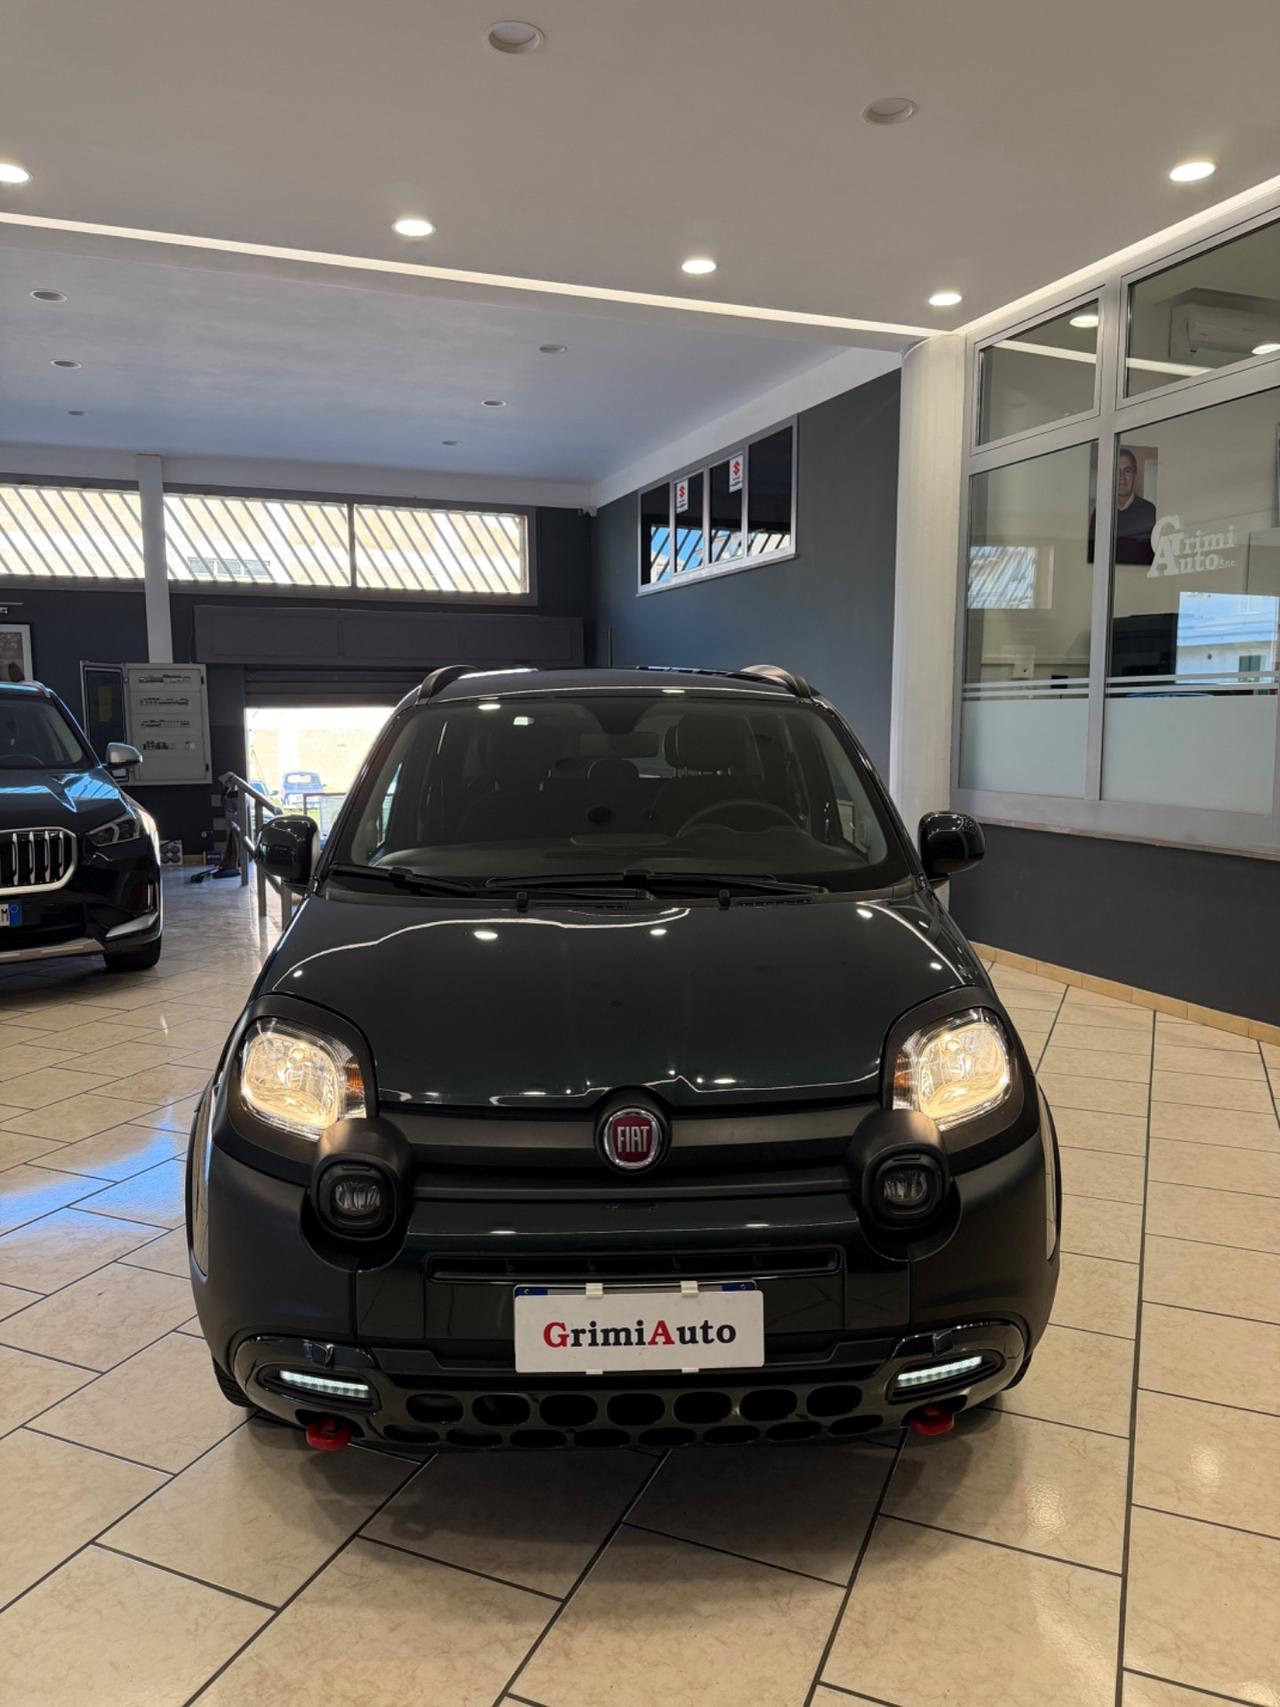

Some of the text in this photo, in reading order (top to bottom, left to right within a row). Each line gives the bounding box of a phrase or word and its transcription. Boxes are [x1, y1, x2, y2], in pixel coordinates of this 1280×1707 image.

[1151, 515, 1235, 555] Grimi
[1147, 536, 1218, 578] Auto
[617, 1126, 650, 1153] FIAT
[543, 1320, 737, 1348] GrimiAuto
